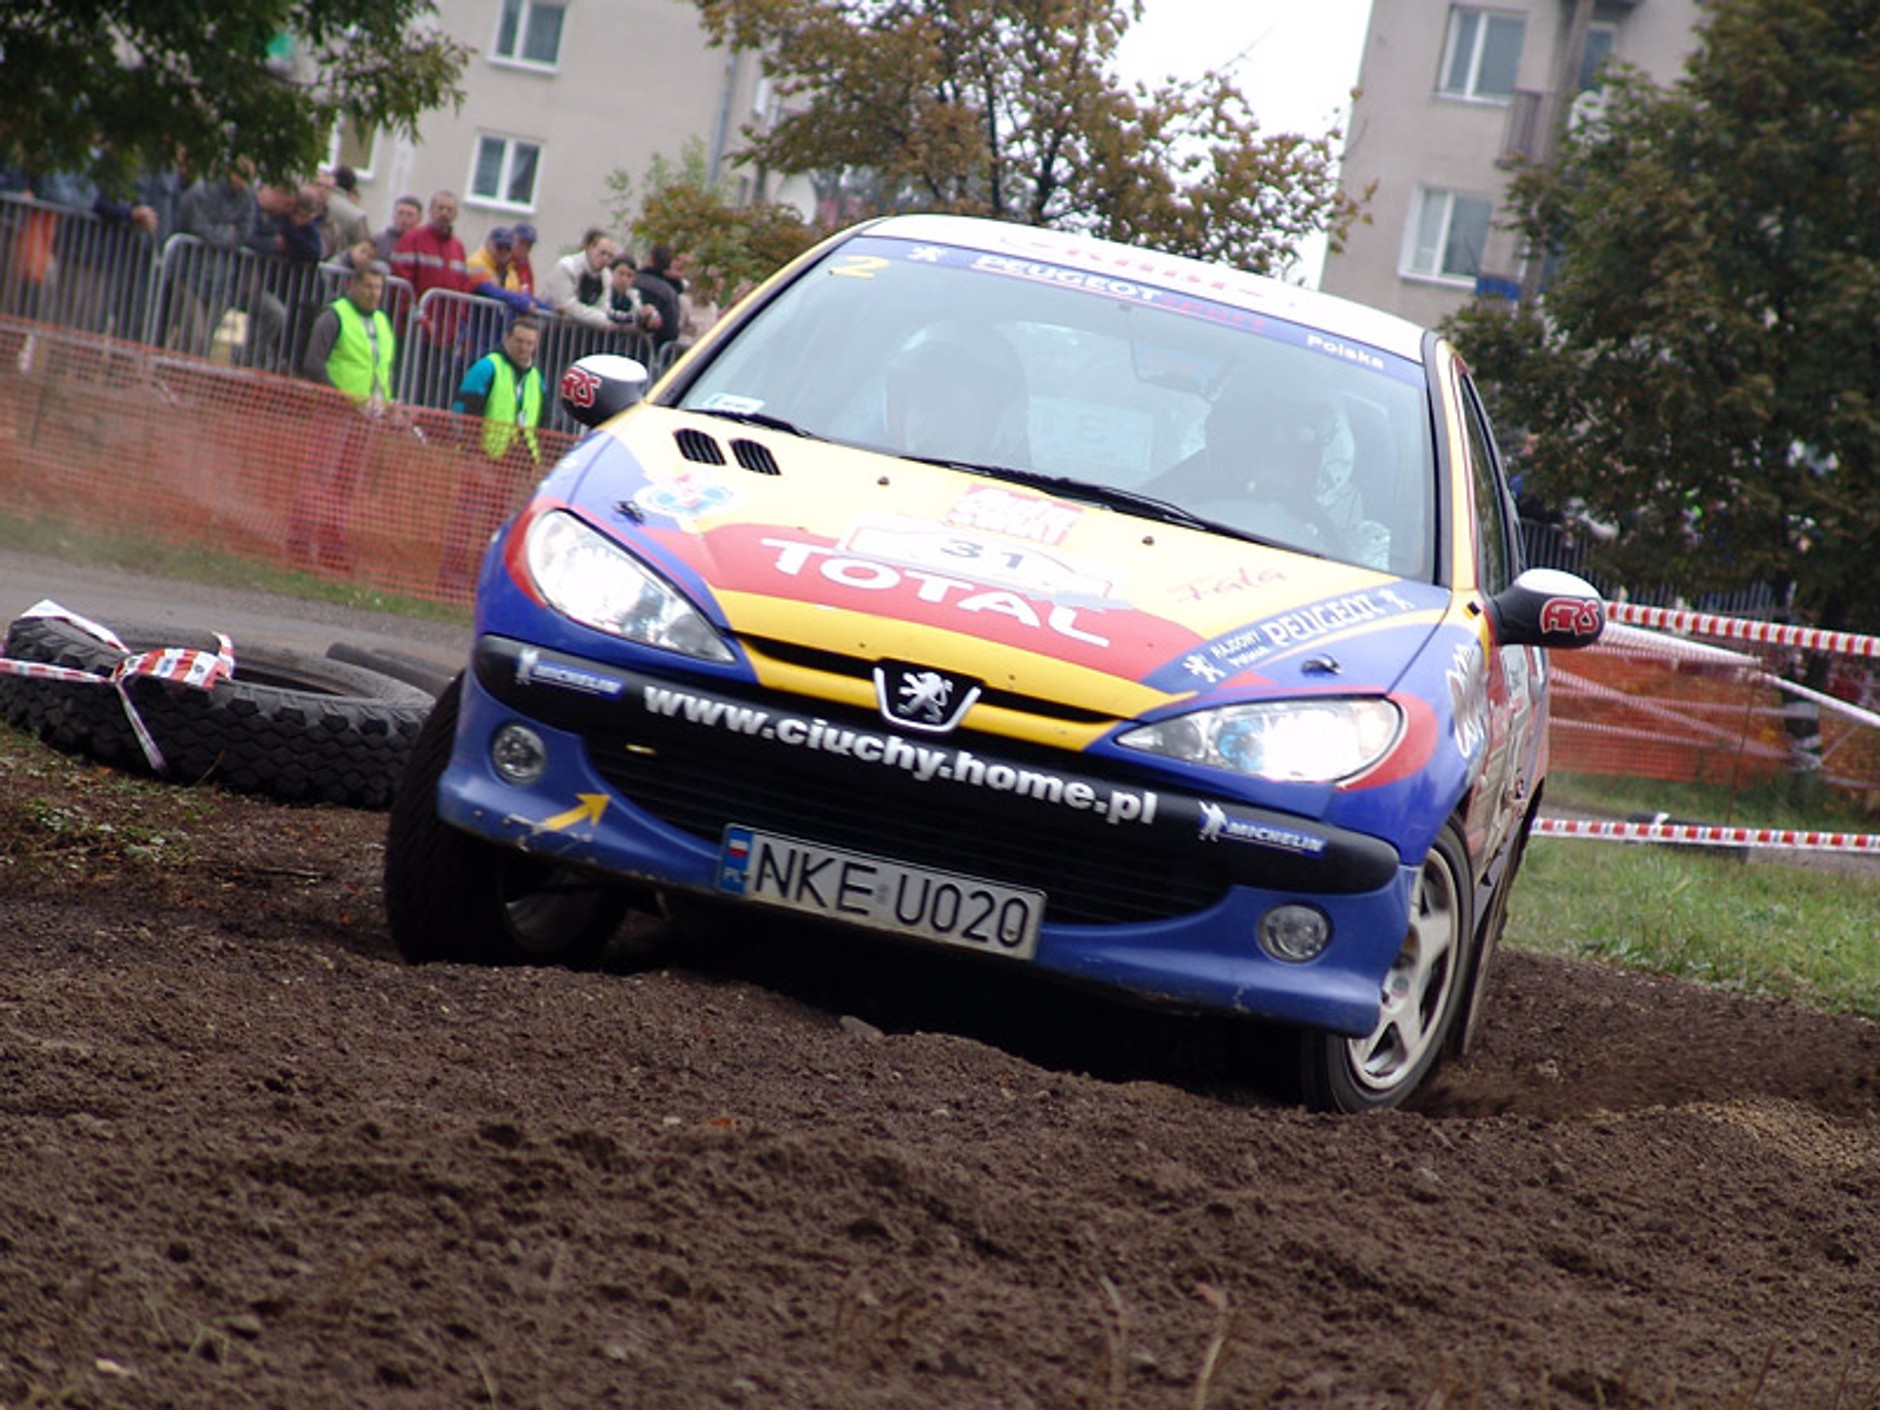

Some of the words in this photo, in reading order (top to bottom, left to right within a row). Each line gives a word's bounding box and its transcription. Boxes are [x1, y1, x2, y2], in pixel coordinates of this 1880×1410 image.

[972, 254, 1163, 300] PEUGEOT
[1306, 334, 1385, 370] Polska
[940, 538, 1025, 569] 31
[760, 536, 1110, 648] TOTAL
[1260, 594, 1387, 647] PEUGEOT
[643, 685, 1158, 826] www.ciuchy.home.pl
[1228, 820, 1326, 852] MICHELIN
[753, 842, 878, 916] NKE
